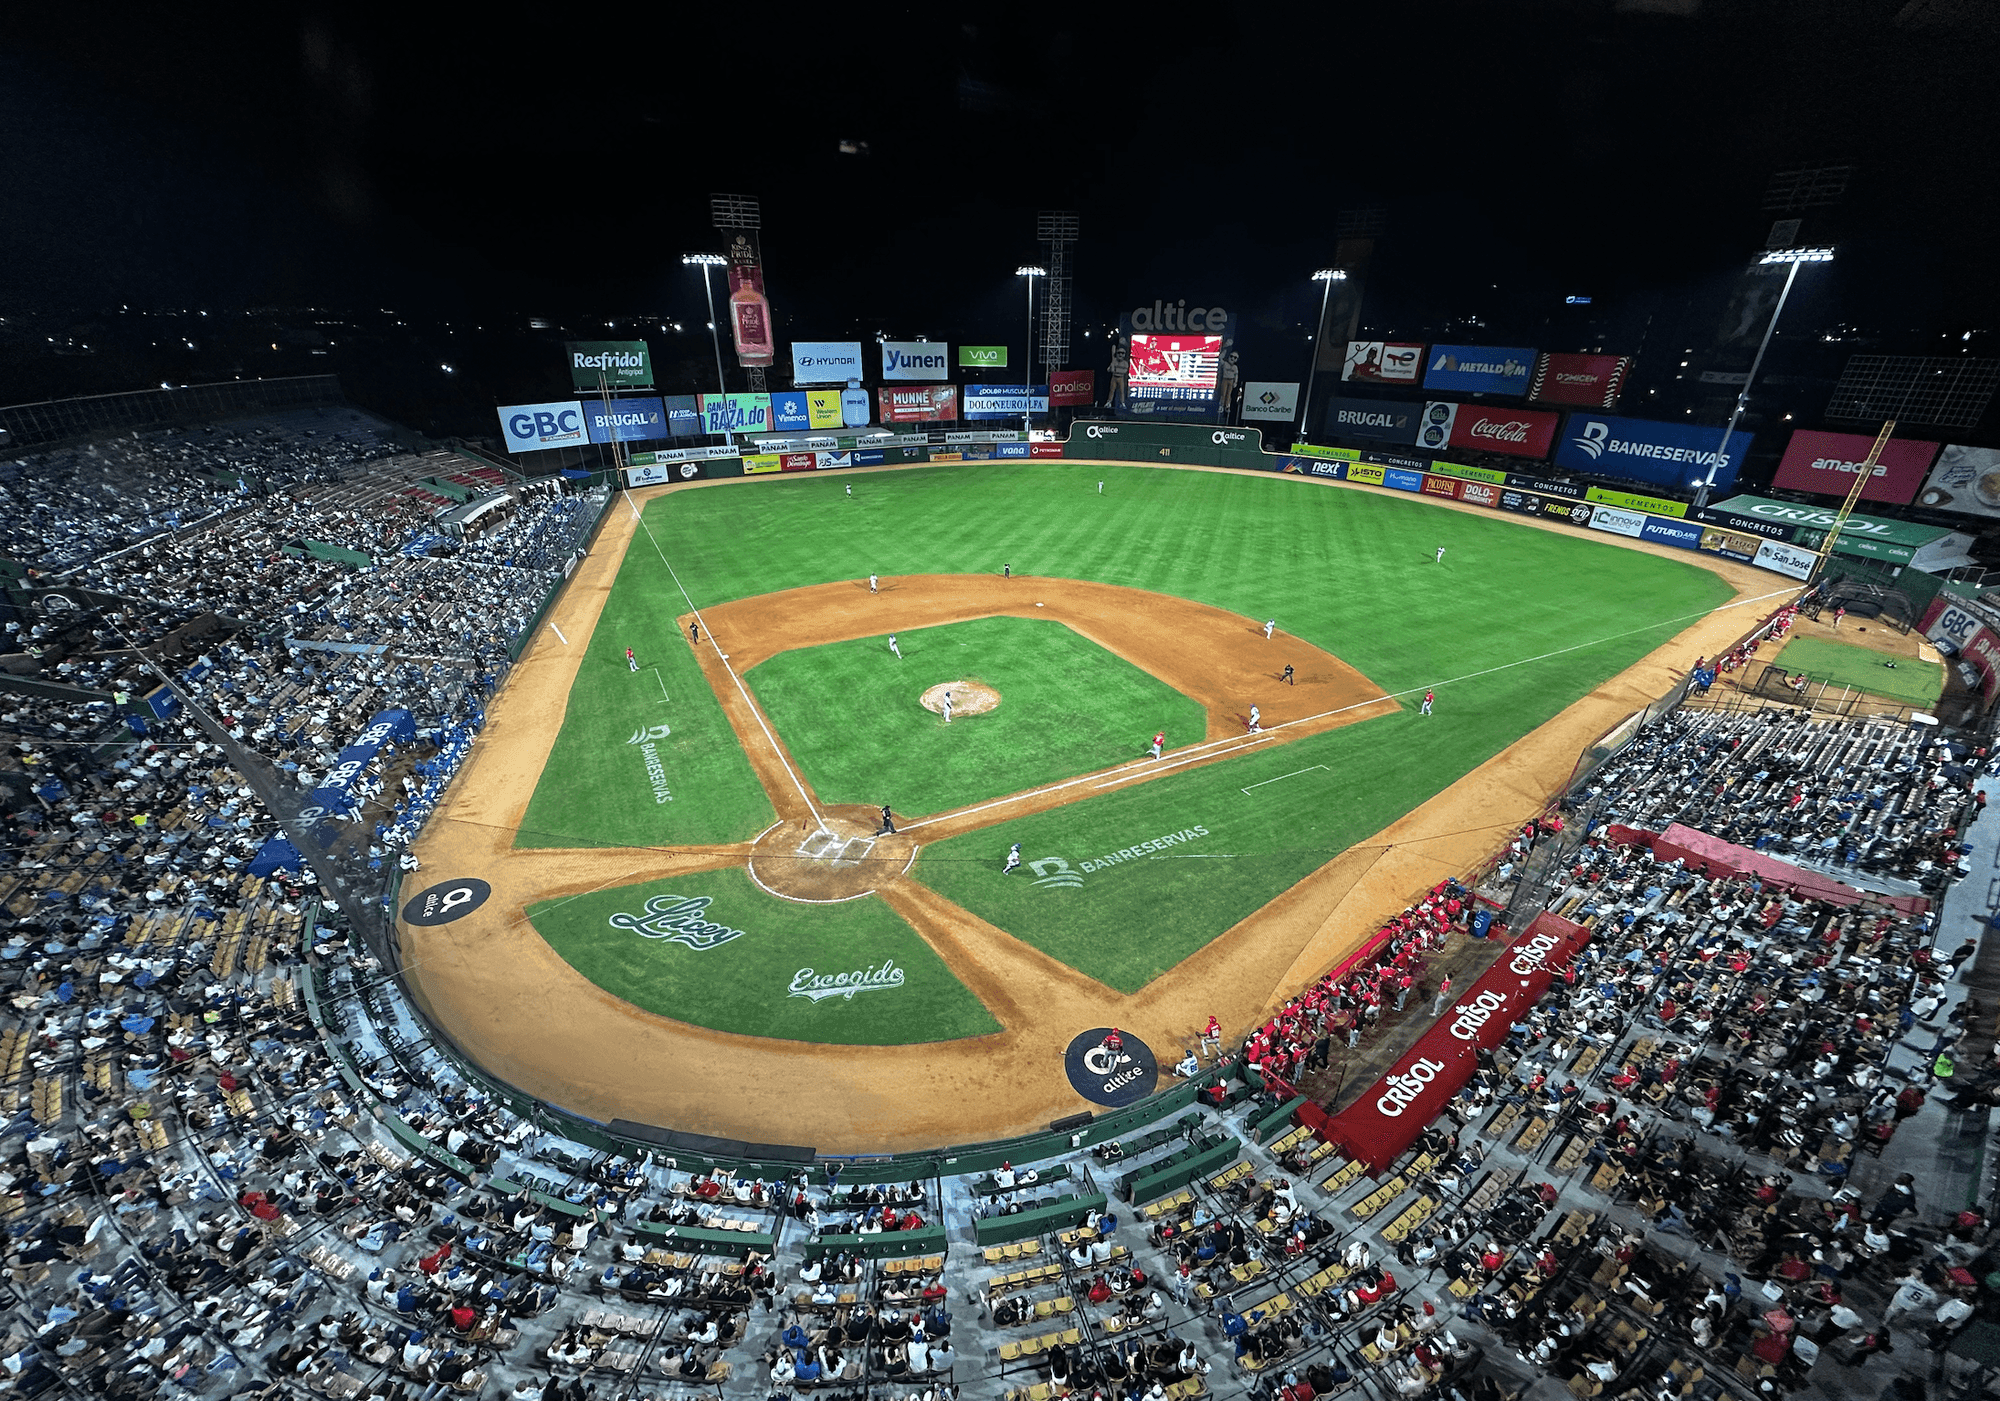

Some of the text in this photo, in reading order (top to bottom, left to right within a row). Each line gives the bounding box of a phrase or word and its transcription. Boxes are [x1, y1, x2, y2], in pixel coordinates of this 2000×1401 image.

[730, 250, 754, 258] PRIDE
[1131, 299, 1228, 331] altice
[573, 351, 643, 371] Resfridol
[816, 357, 855, 366] HYUNDAI
[886, 350, 945, 371] Yunen
[617, 368, 643, 376] Antigripal
[893, 389, 930, 405] MUNNÉ
[707, 401, 725, 413] GANA
[728, 399, 737, 410] EN
[1245, 405, 1292, 414] Banco Caribe
[509, 410, 580, 439] GBC
[594, 412, 648, 427] BRUGAL
[777, 414, 807, 423] Vimenco
[1337, 410, 1394, 428] BRUGAL
[1098, 426, 1119, 434] altice
[1224, 432, 1245, 441] altice
[761, 444, 788, 452] PANAM
[858, 438, 882, 446] PANAM
[657, 452, 684, 460] PANAM
[708, 448, 737, 456] PANAM
[1318, 449, 1351, 458] CEMENTOS
[1607, 439, 1731, 468] BANRESERVAS
[1312, 461, 1340, 475] next
[1388, 458, 1423, 468] CONCRETOS
[1811, 458, 1888, 477] amada
[1389, 472, 1417, 482] Humano
[1460, 469, 1496, 480] CEMENTOS
[1533, 482, 1578, 495] CONCRETOS
[1544, 503, 1590, 518] FRENOS grip
[1625, 498, 1675, 512] CEMENTOS
[1610, 515, 1642, 527] innova
[1729, 518, 1784, 536] CONCRETOS
[1750, 504, 1893, 535] CRISOL
[1772, 552, 1789, 564] San
[1789, 557, 1811, 571] José
[1941, 609, 1975, 638] GBC
[361, 722, 392, 746] GBC
[328, 760, 362, 788] GBC
[640, 742, 673, 804] BANRESERVAS
[1078, 825, 1210, 873] BANRESERVAS
[422, 893, 439, 917] altice
[609, 894, 746, 951] Licey
[1509, 932, 1560, 975] CRISOL
[786, 959, 906, 1003] Escogido
[1449, 989, 1507, 1040] CRISOL
[1103, 1065, 1144, 1093] altice
[1376, 1056, 1445, 1117] CRISOL
